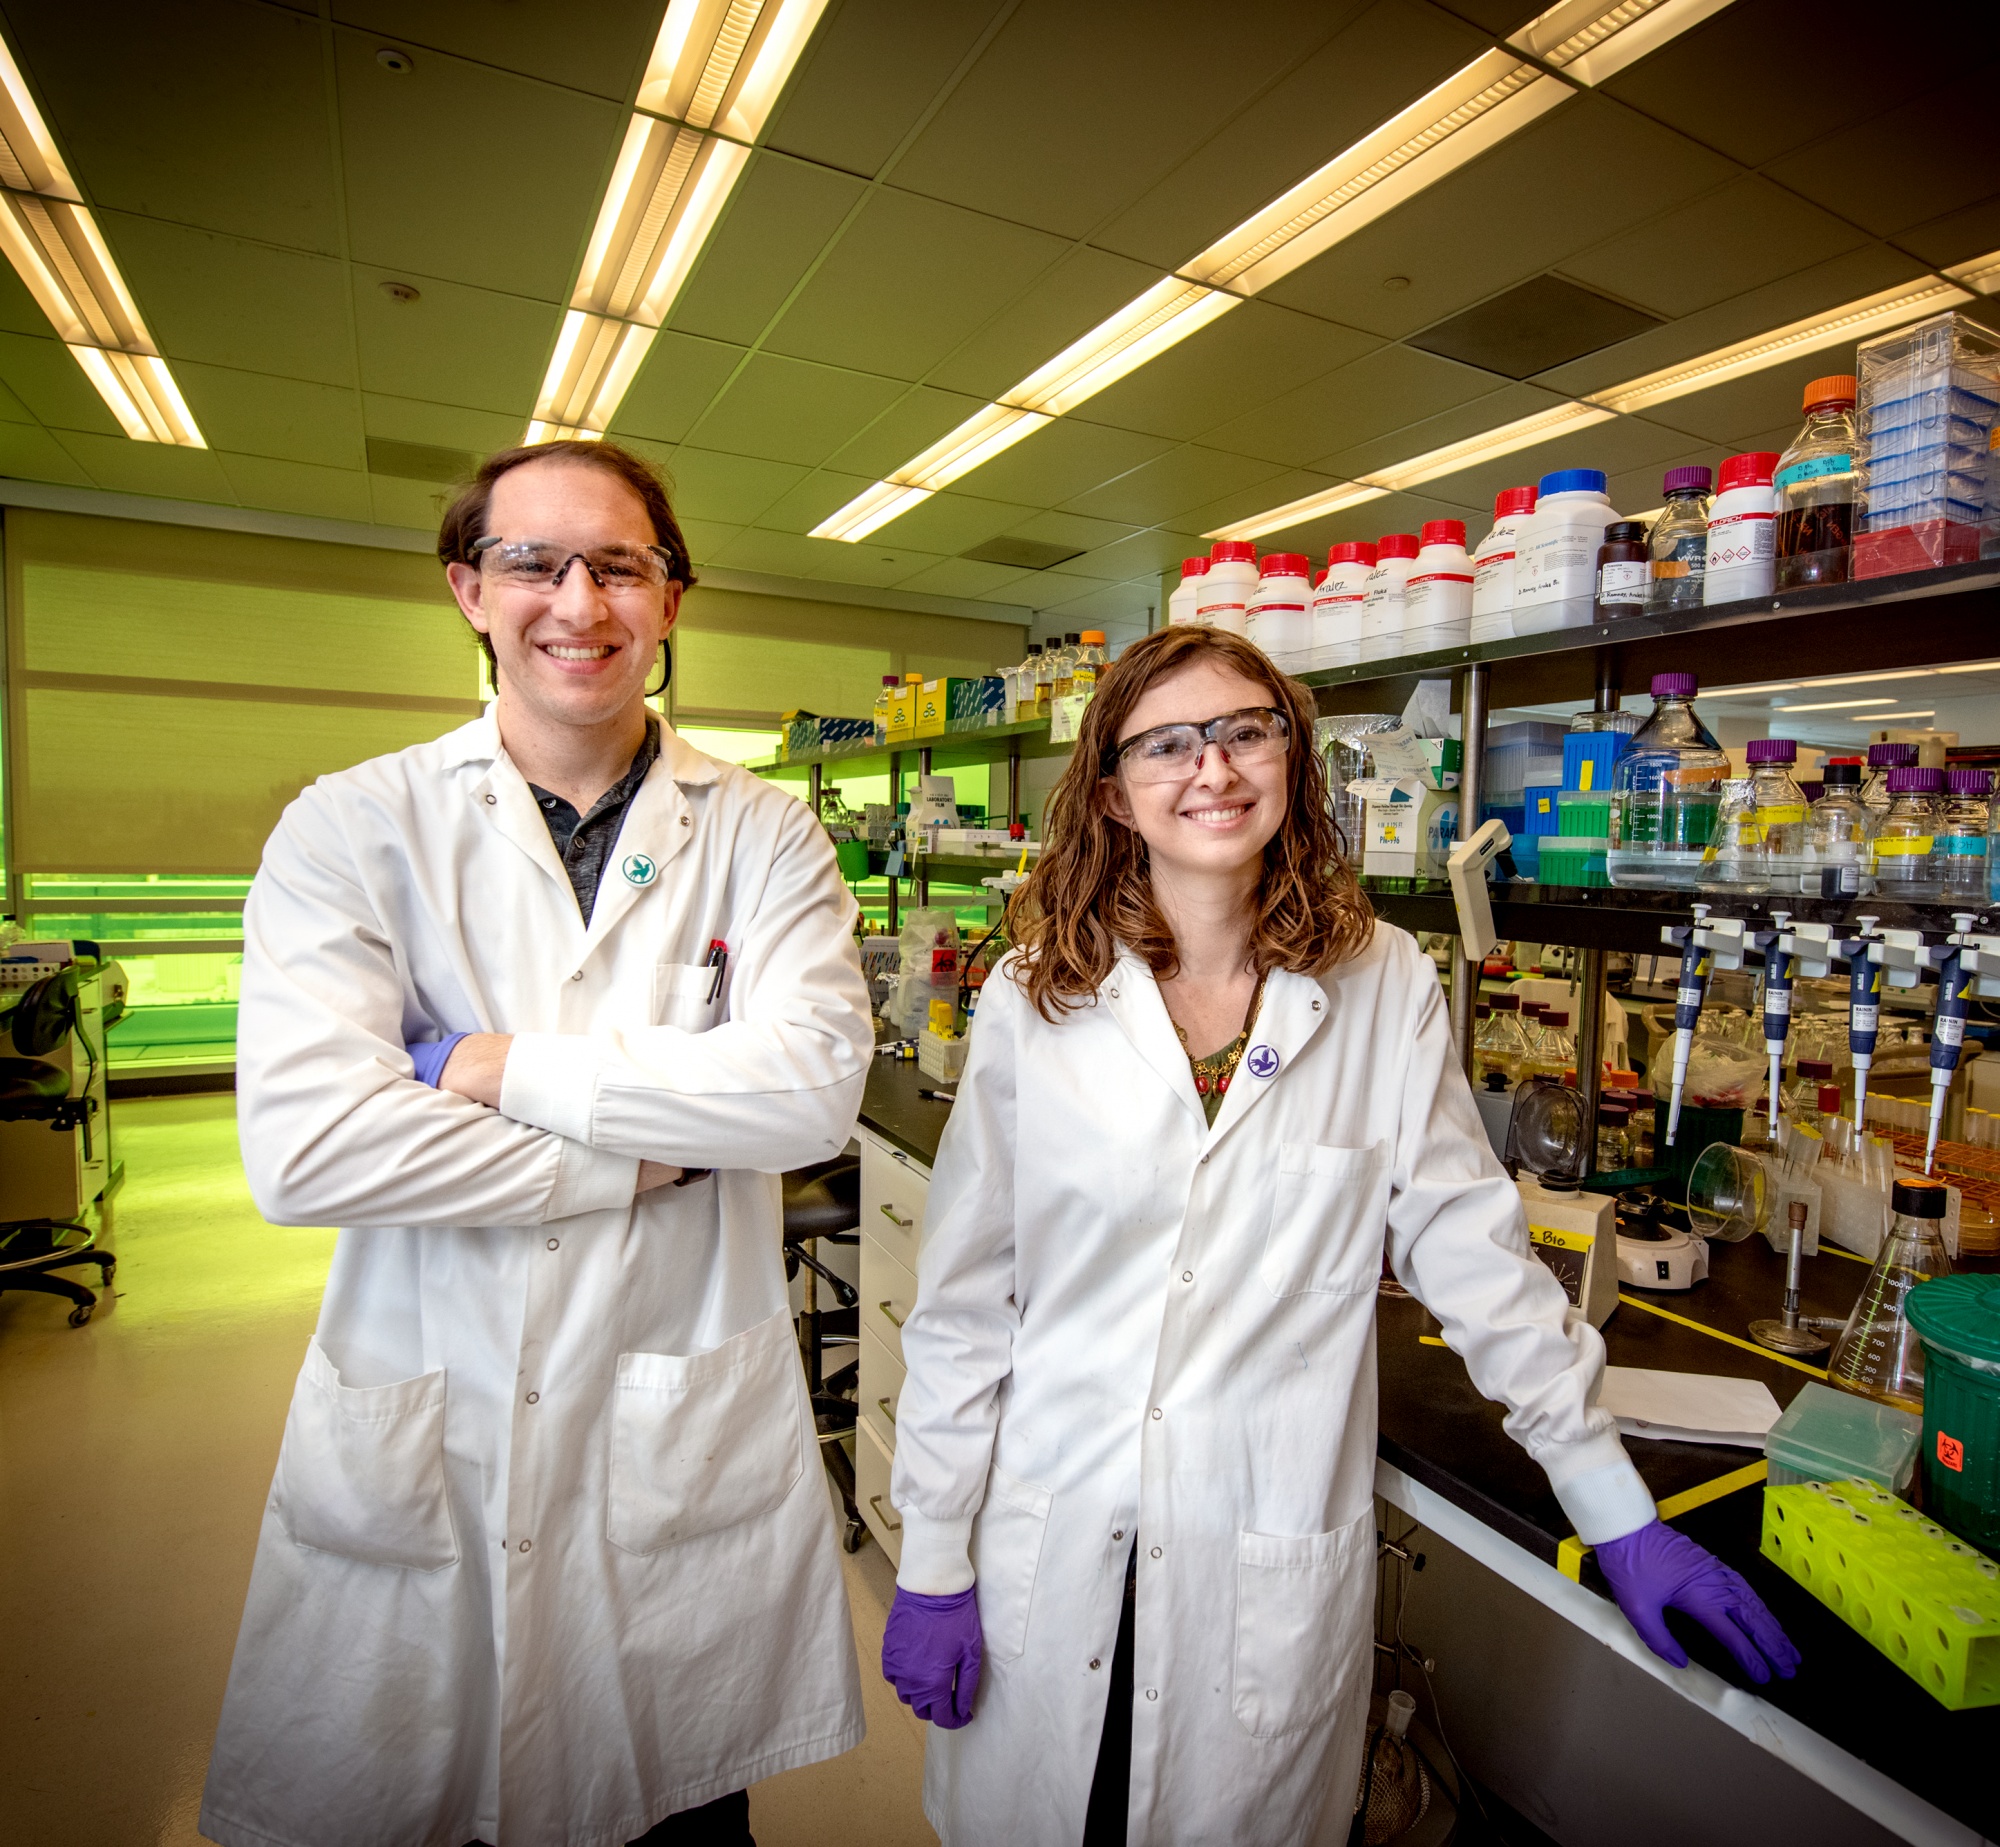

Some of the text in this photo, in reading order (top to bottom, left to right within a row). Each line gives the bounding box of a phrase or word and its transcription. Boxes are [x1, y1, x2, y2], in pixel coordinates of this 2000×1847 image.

[1711, 514, 1743, 527] ALDRICH
[1428, 826, 1457, 839] PARAFI
[1940, 1017, 1958, 1025] RAININ
[1543, 1231, 1565, 1246] Bio
[1888, 1278, 1904, 1288] 1000
[1883, 1303, 1897, 1312] 900
[1877, 1323, 1890, 1332] 800
[1872, 1338, 1885, 1347] 700
[1868, 1353, 1880, 1361] 600
[1863, 1365, 1876, 1374] 500
[1861, 1375, 1873, 1384] 400
[1858, 1385, 1870, 1394] 300
